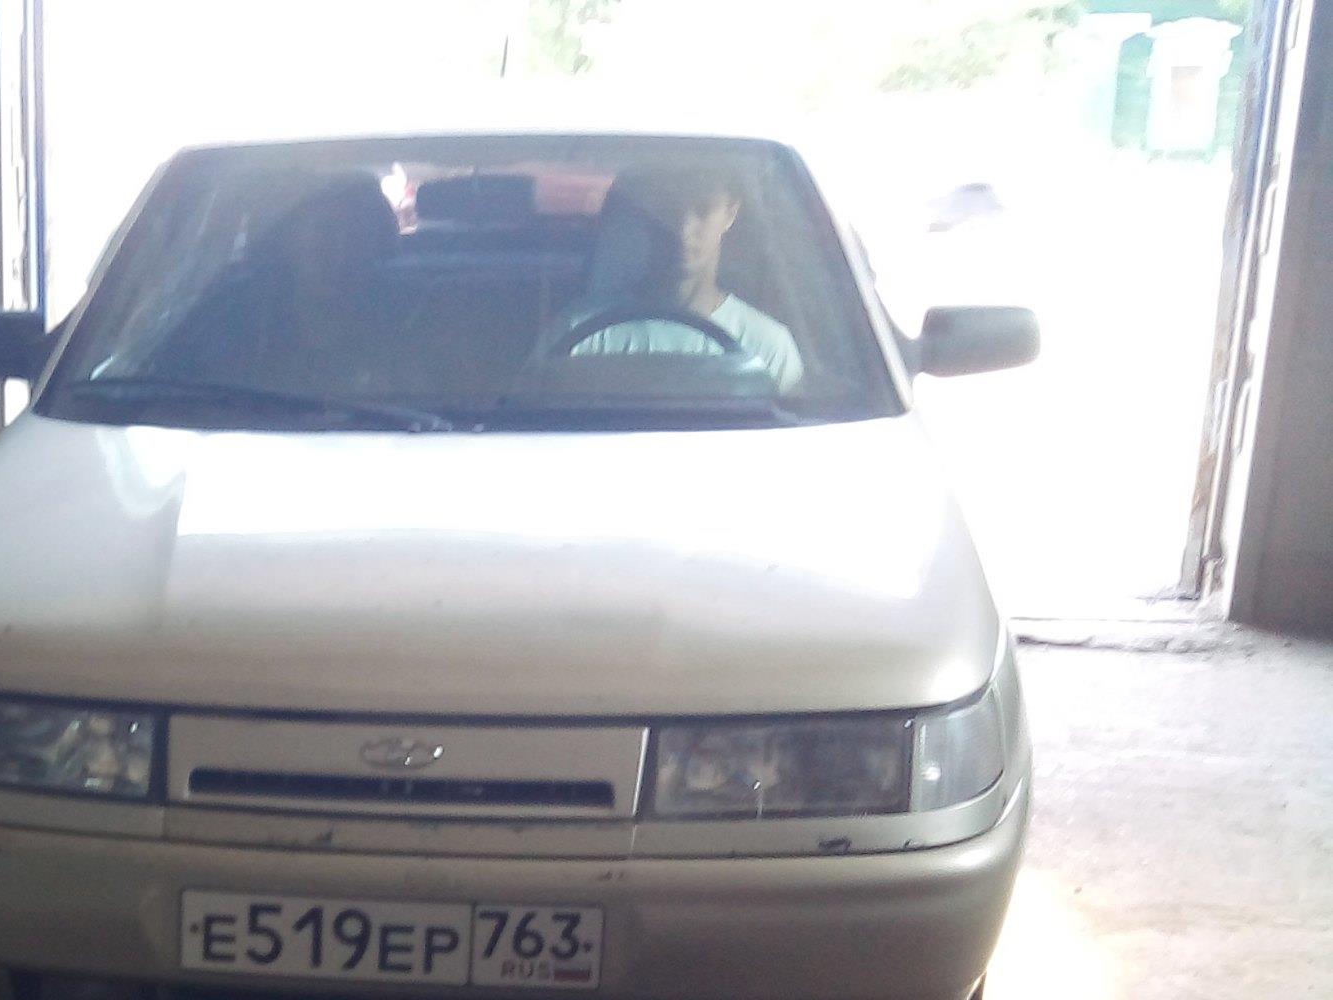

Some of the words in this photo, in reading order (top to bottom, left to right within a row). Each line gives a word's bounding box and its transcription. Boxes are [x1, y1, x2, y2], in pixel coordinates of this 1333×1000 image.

[202, 903, 460, 974] E519EP
[478, 910, 581, 959] 763
[501, 960, 551, 980] RUS
